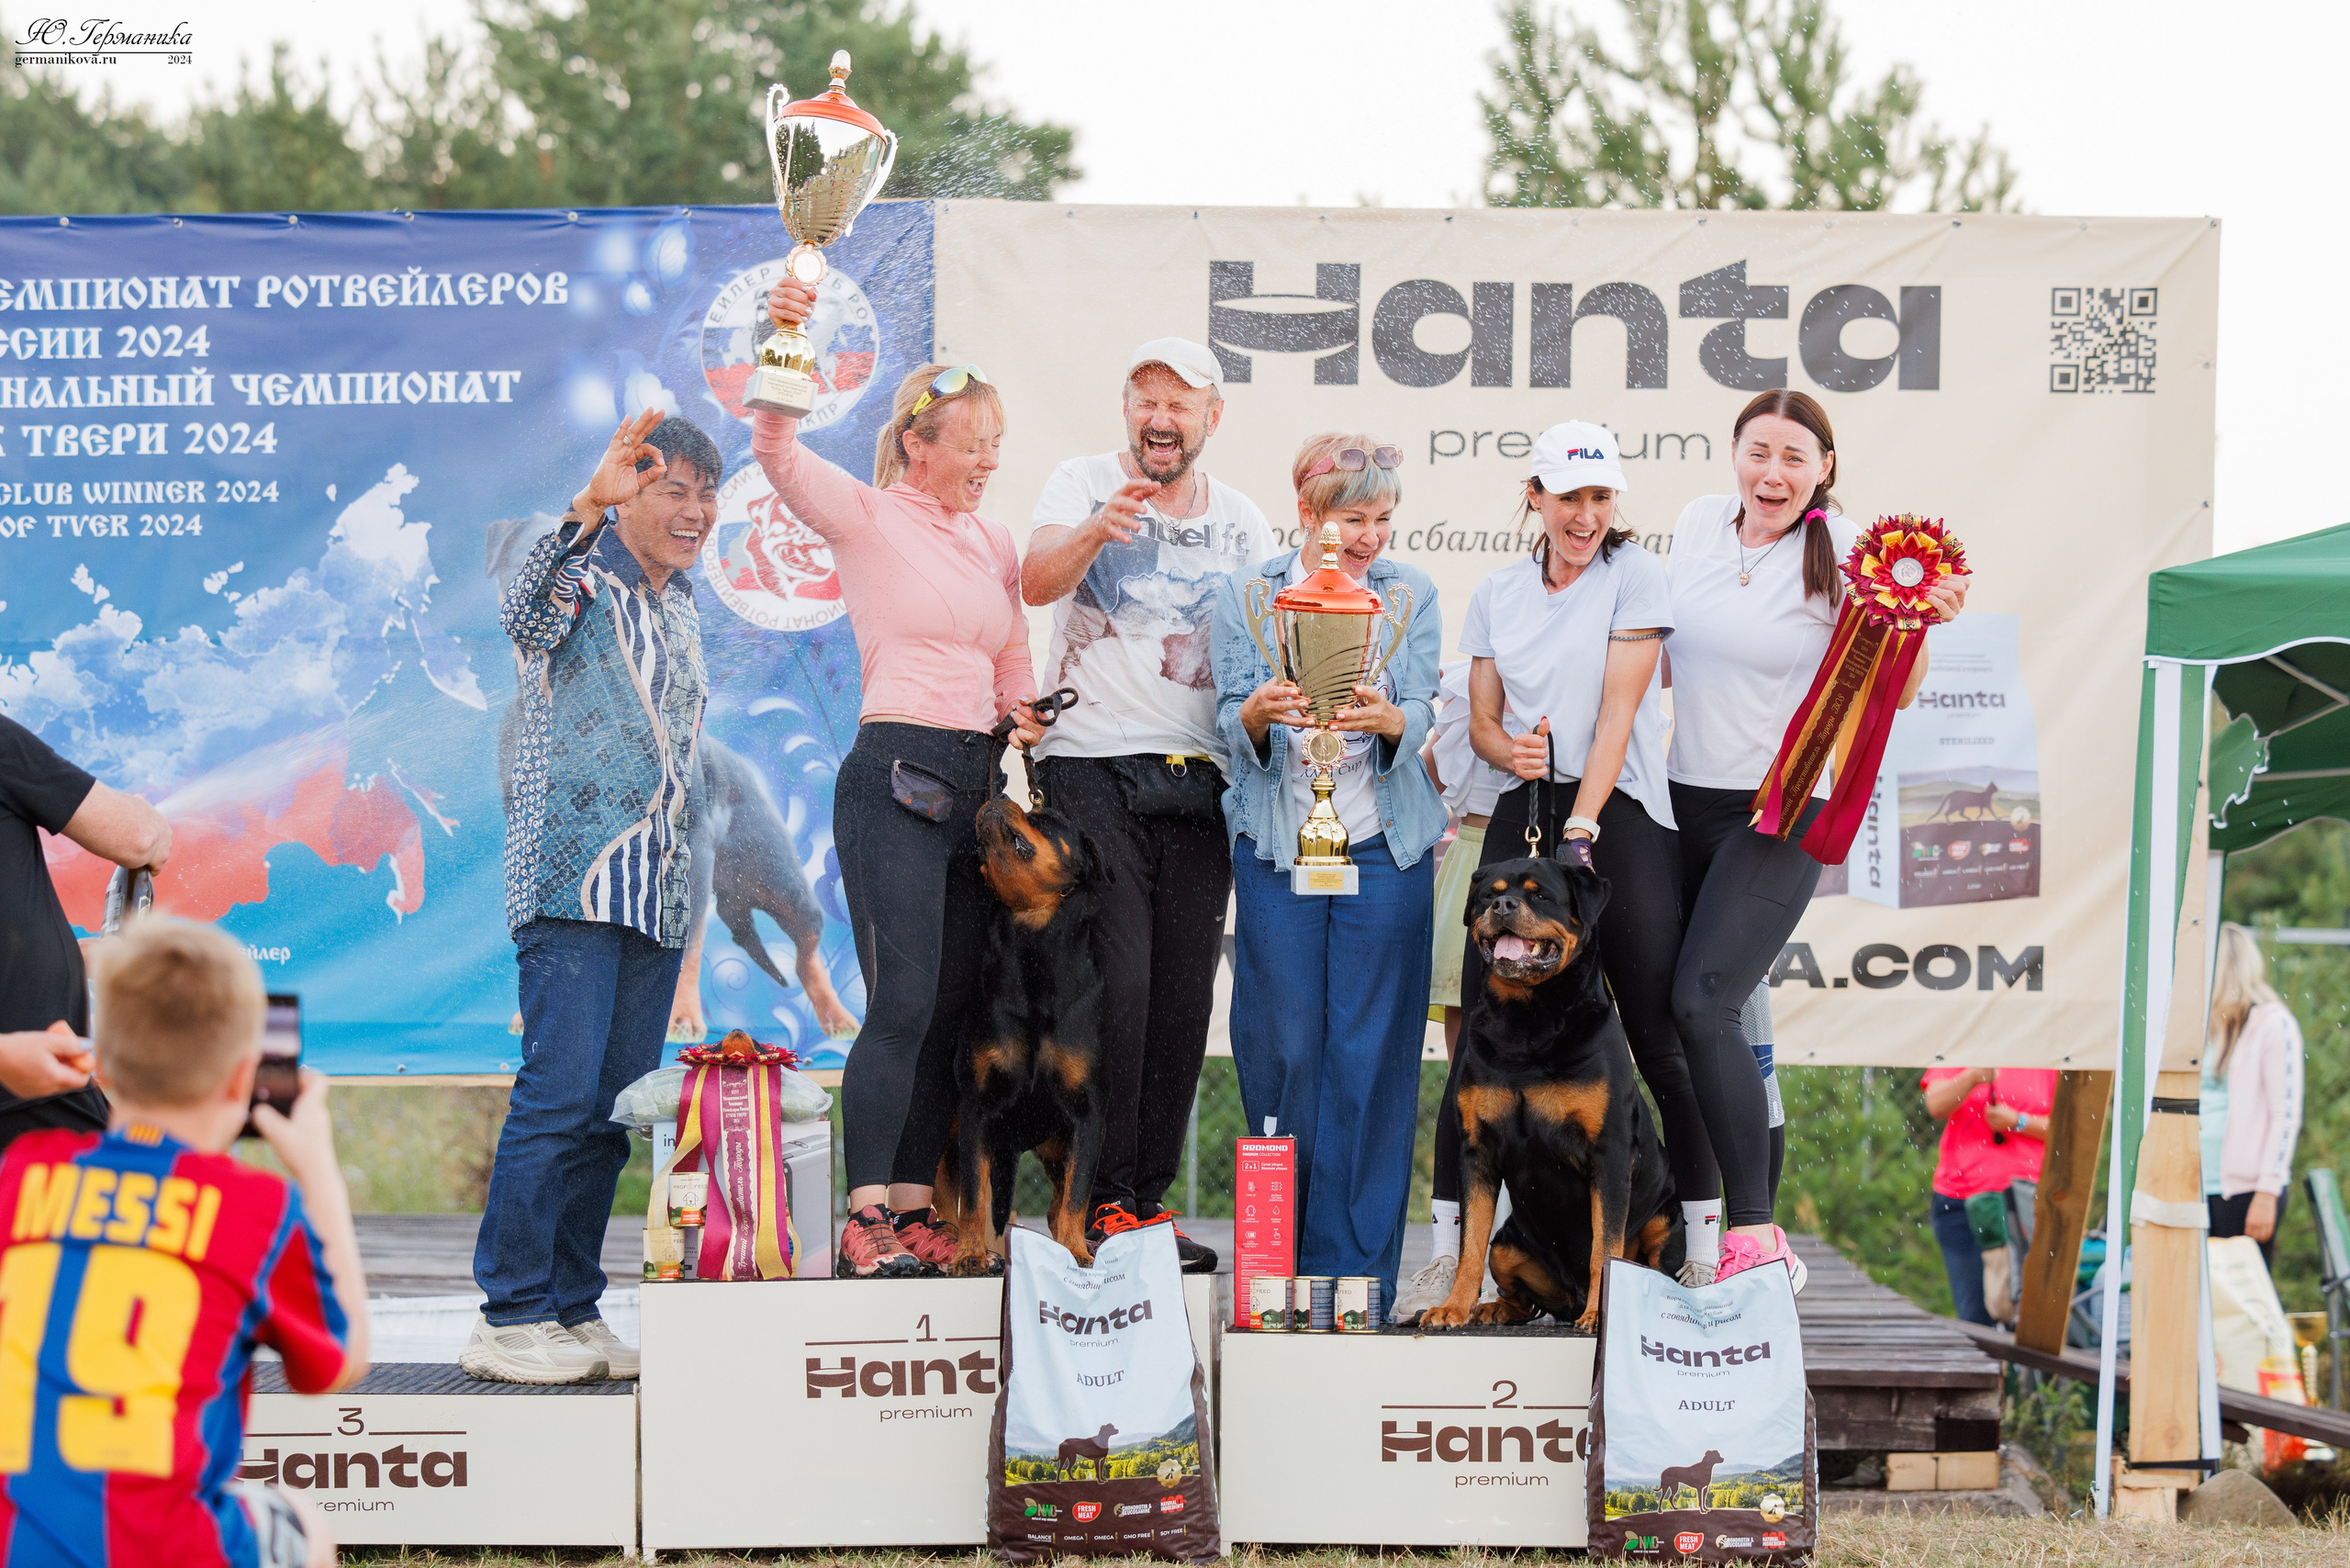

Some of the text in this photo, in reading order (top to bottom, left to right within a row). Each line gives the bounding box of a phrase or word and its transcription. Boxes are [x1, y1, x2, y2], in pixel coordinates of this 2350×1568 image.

[254, 266, 569, 308] РОТВЕЙЛЕРОВ
[1209, 259, 1942, 393] Hanta
[0, 324, 211, 361] СИИ 2024
[229, 370, 521, 408] ЧЕМПИОНАТ
[21, 421, 278, 457] ТВЕРИ 2024
[1429, 423, 1711, 466] preum
[1567, 447, 1605, 461] FILA
[83, 480, 207, 505] WINNER
[216, 479, 280, 505] 2024
[0, 513, 204, 540] OF TVER 2024
[1918, 689, 2007, 711] Hanta
[1939, 736, 1995, 746] STERILIZED
[11, 1163, 222, 1262] MESSI
[915, 1314, 938, 1342] 1
[1039, 1299, 1153, 1335] Hanta
[1666, 1313, 1707, 1330] говядинй
[1069, 1337, 1120, 1349] premium
[1640, 1334, 1772, 1368] Hanta
[0, 1241, 202, 1478] 19
[805, 1350, 1003, 1399] Hant
[1076, 1370, 1125, 1388] ADULT
[1676, 1369, 1730, 1379] premium
[1492, 1380, 1518, 1409] 2
[1678, 1398, 1736, 1413] ADULT
[337, 1407, 365, 1436] 3
[879, 1405, 973, 1422] premium
[1382, 1418, 1589, 1463] Hant
[1455, 1472, 1550, 1488] premium
[315, 1498, 396, 1512] remium
[1027, 1533, 1052, 1541] BALANCE
[1680, 1542, 1695, 1551] MEAT
